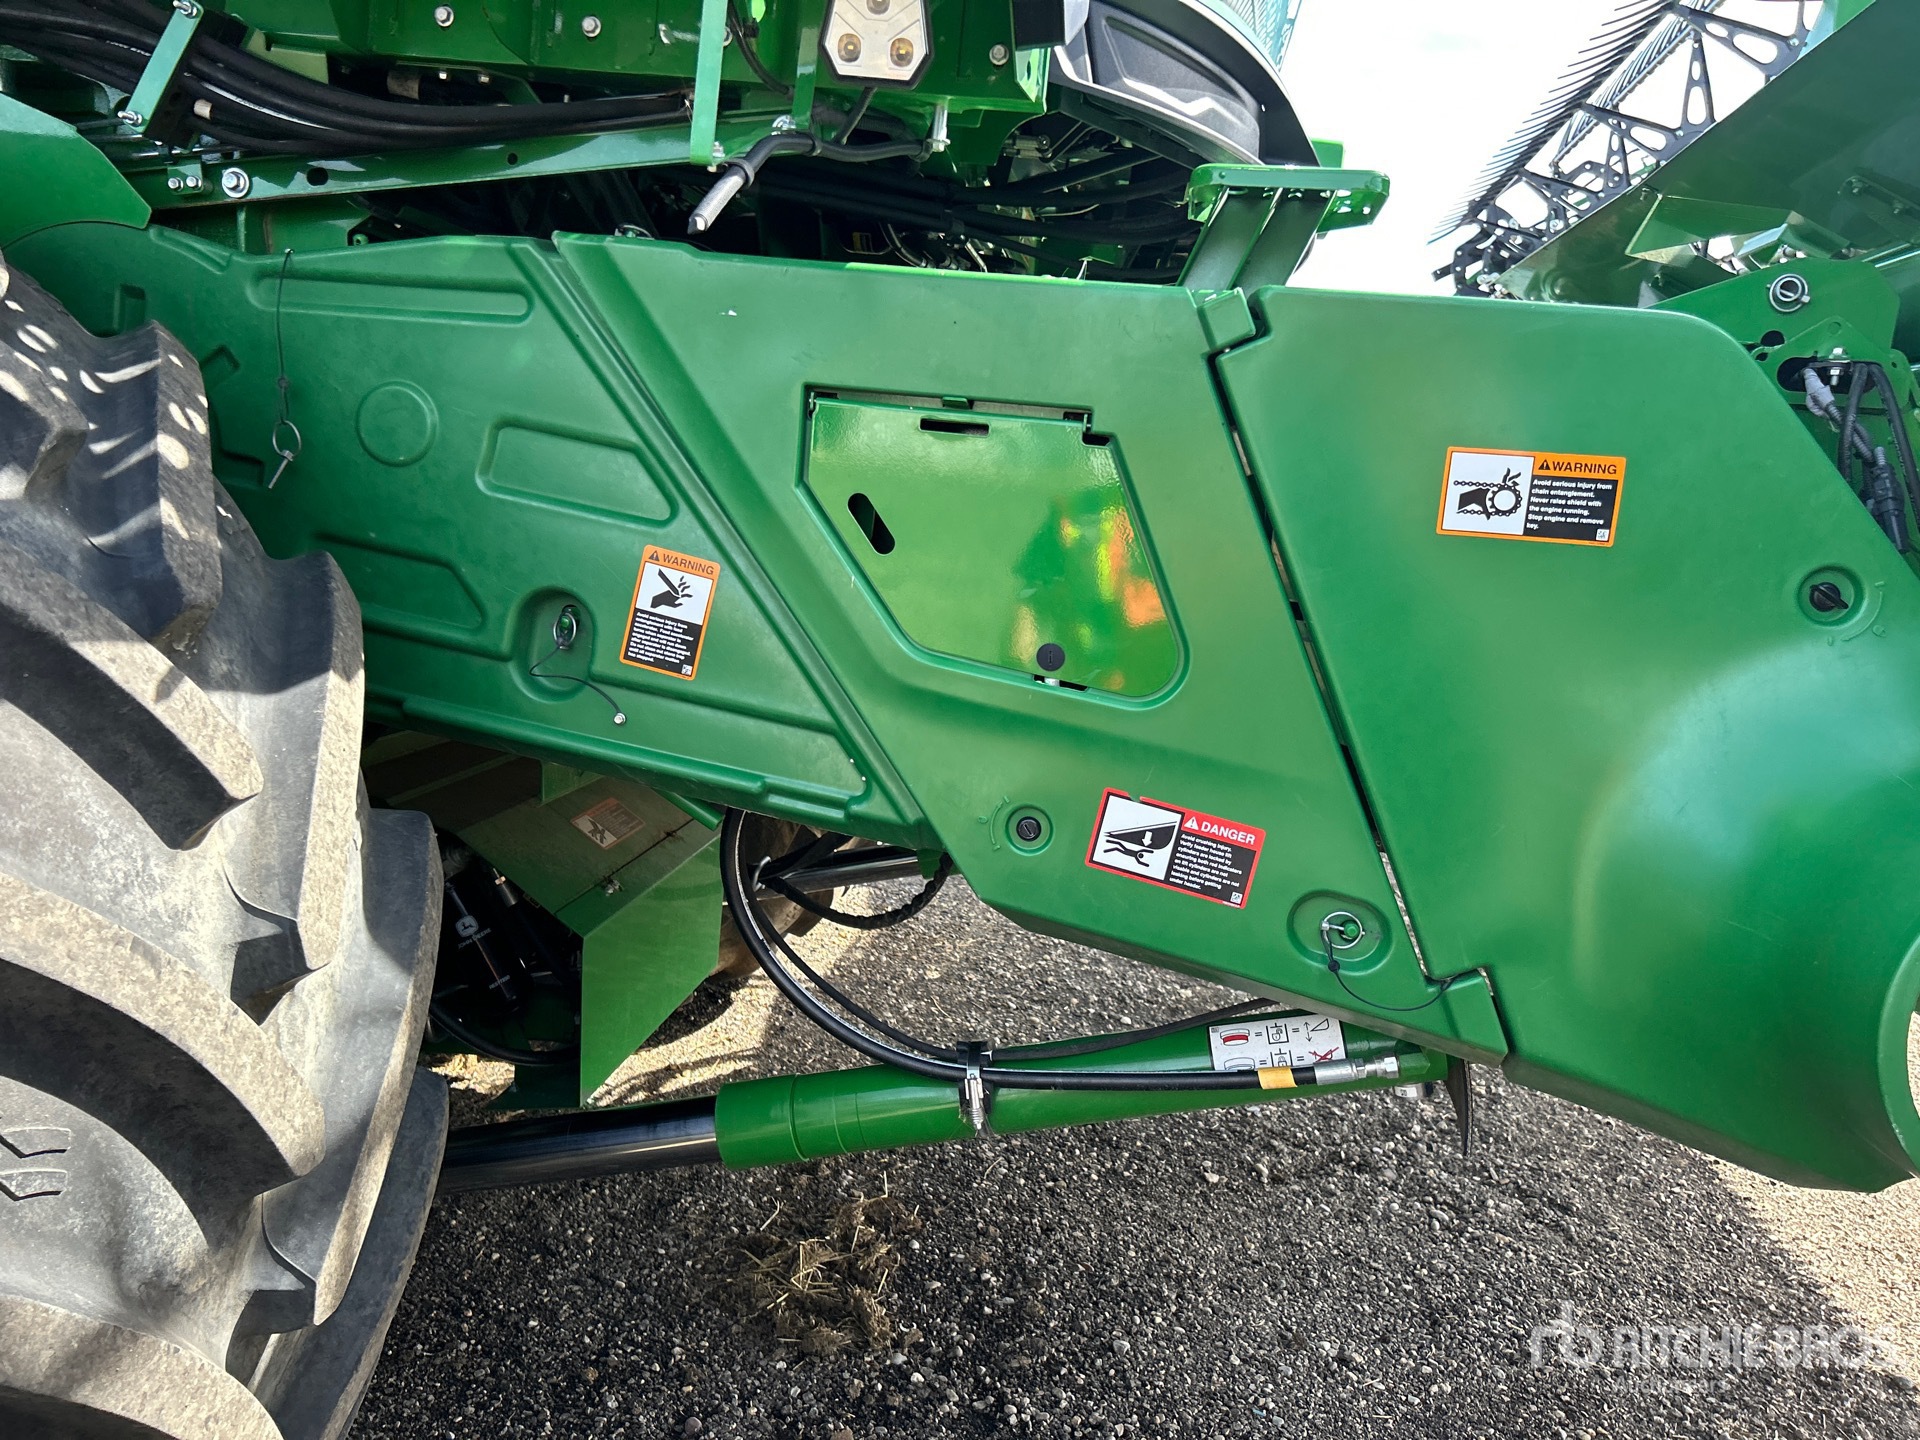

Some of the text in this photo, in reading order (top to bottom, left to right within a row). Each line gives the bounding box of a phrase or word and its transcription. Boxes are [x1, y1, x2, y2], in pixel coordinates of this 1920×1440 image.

[1553, 461, 1617, 474] WARNING
[1577, 481, 1596, 490] injury
[663, 554, 714, 575] WARNING
[1201, 822, 1256, 845] DANGER
